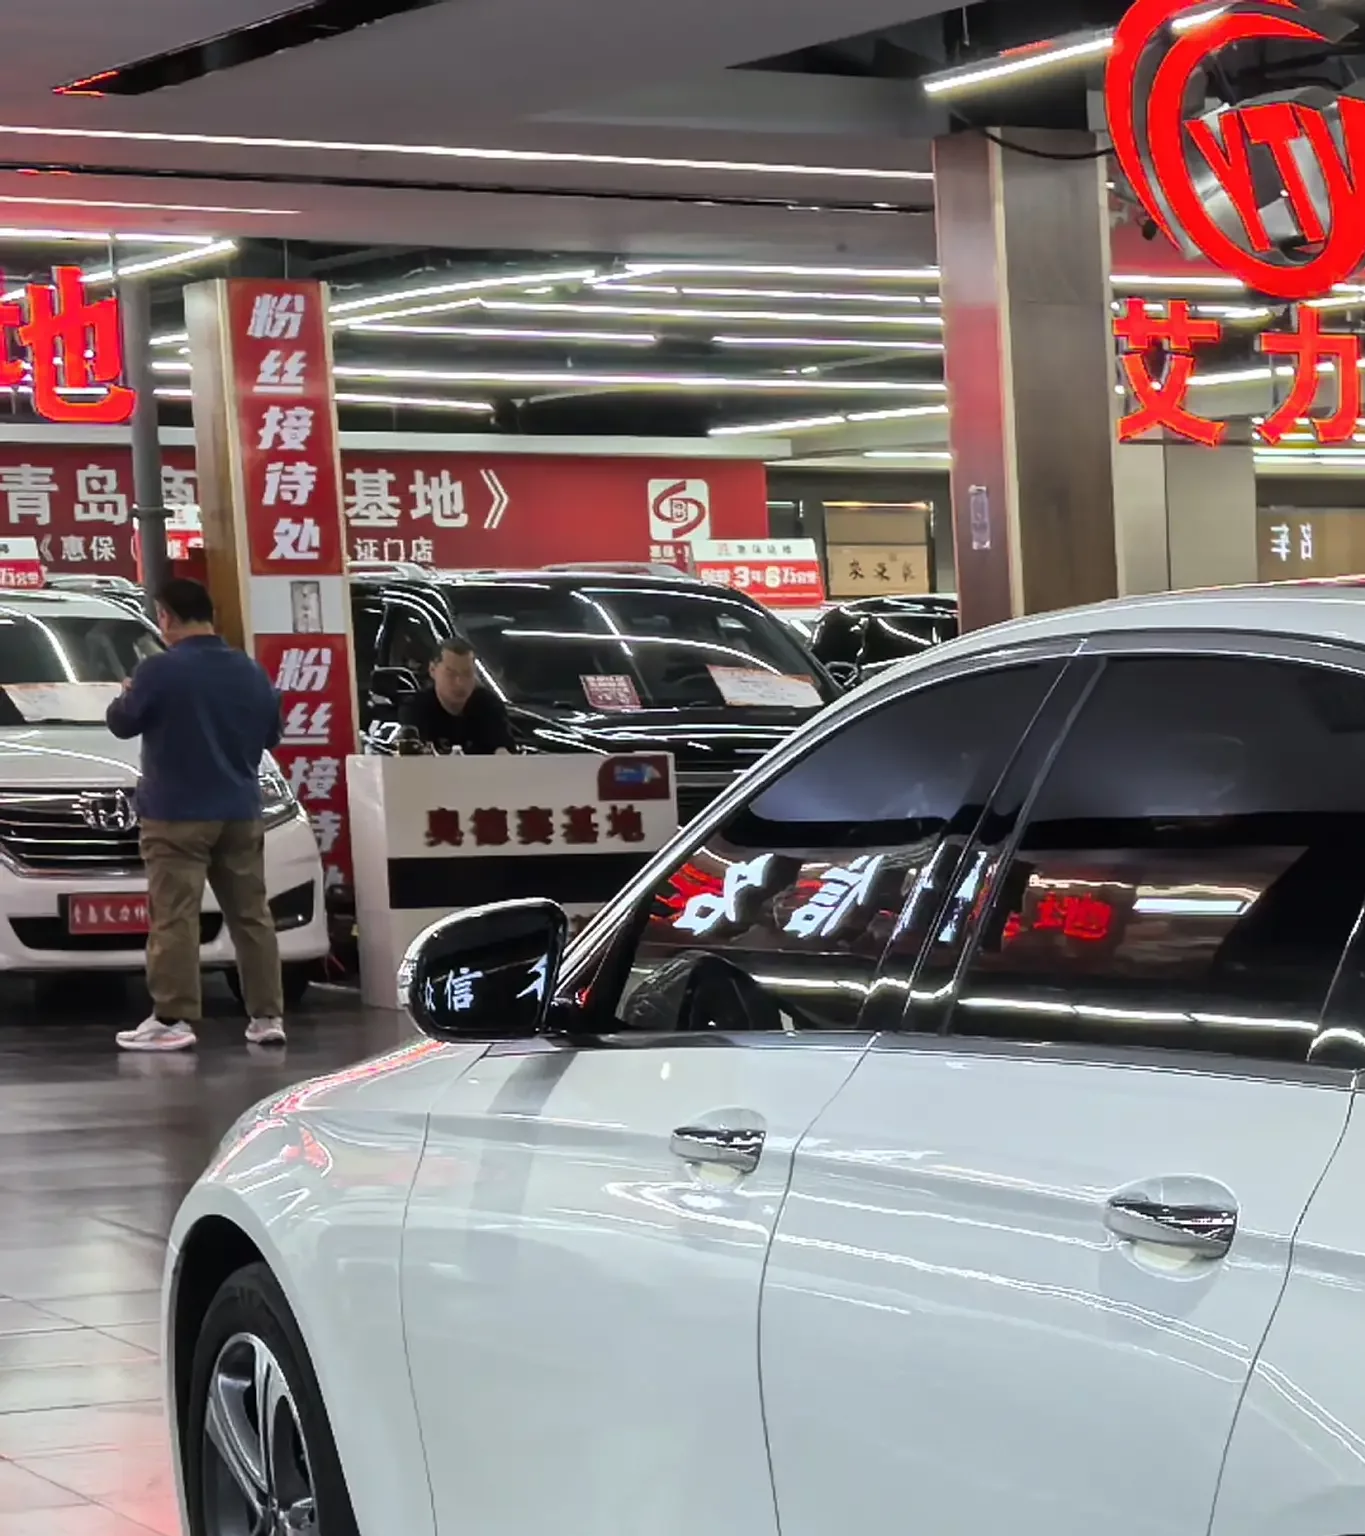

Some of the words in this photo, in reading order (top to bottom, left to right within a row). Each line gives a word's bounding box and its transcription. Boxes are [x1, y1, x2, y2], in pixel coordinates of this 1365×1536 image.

[0, 265, 138, 422] 地
[247, 293, 321, 560] 粉丝接待处
